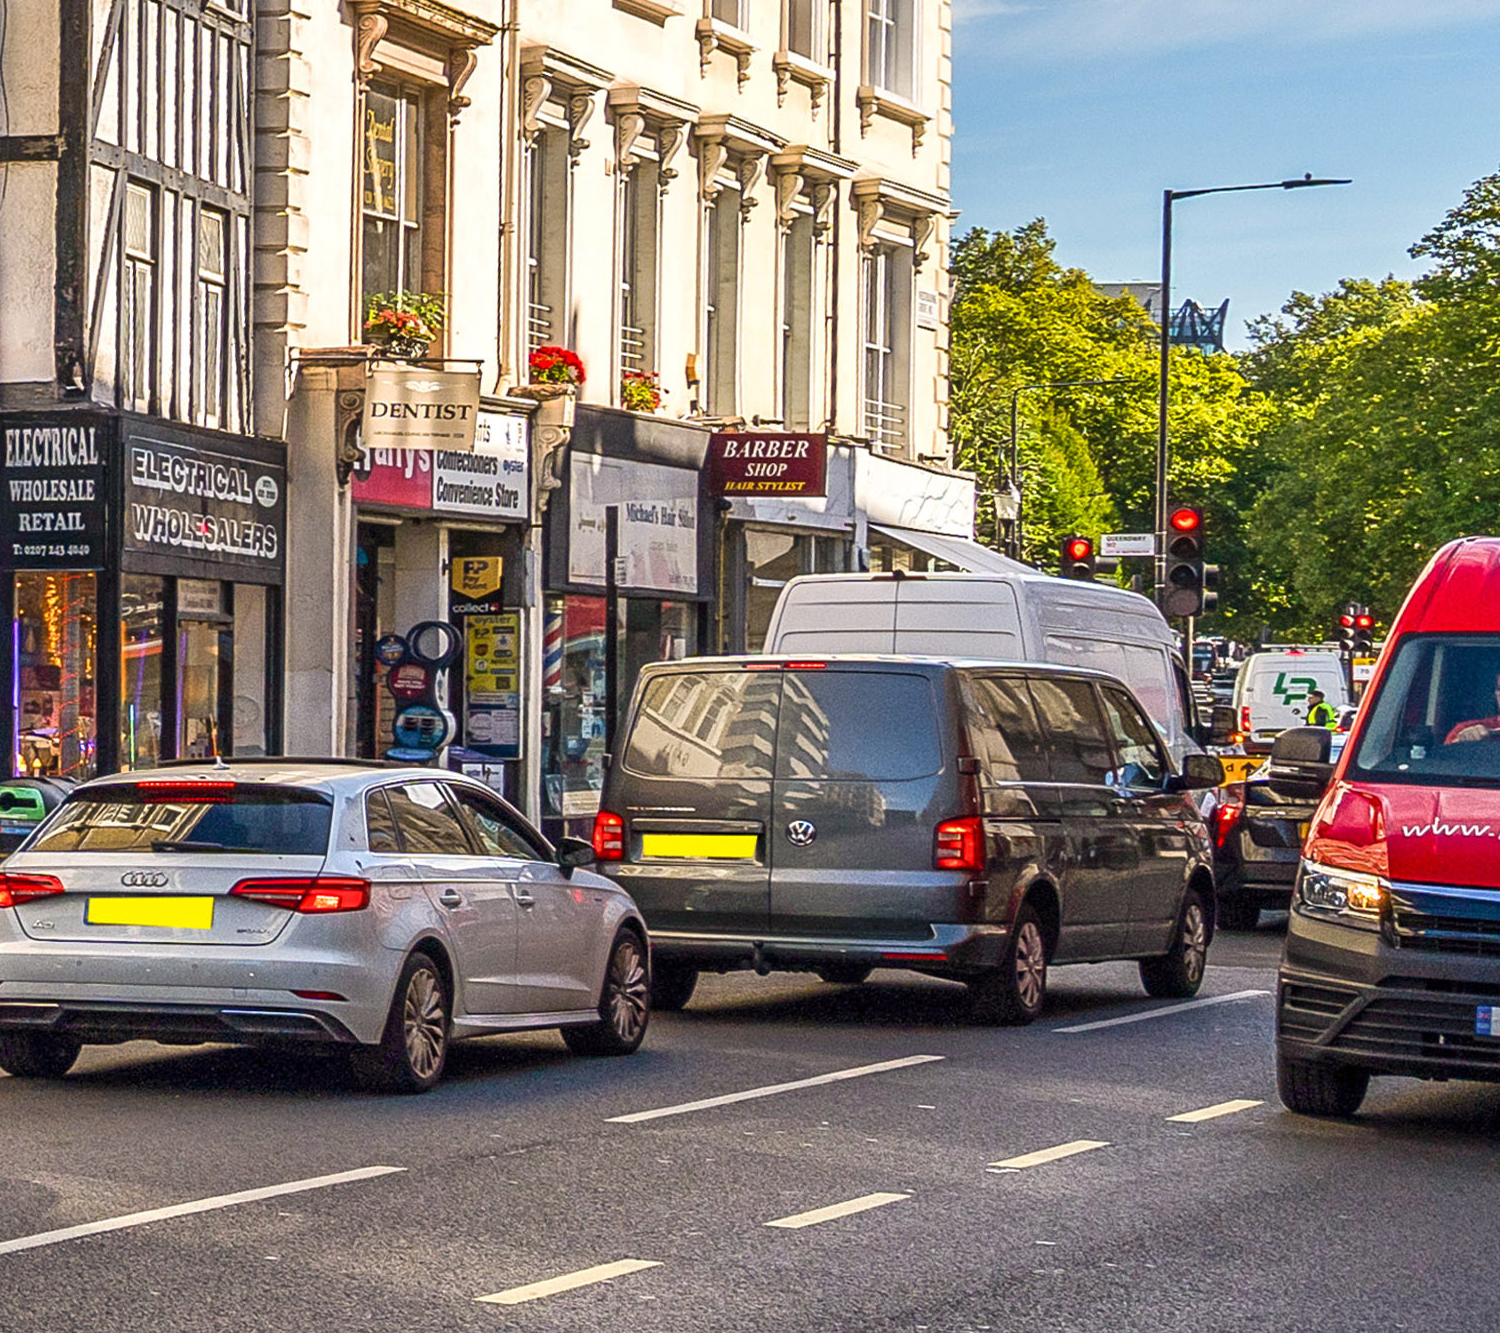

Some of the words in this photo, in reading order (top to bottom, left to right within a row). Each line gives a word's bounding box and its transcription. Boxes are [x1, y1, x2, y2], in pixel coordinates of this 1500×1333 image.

[371, 402, 473, 420] DENTIST
[5, 426, 99, 467] ELECTRICAL
[723, 440, 810, 458] BARBER
[131, 447, 253, 504] ELECTRICAL
[744, 463, 788, 477] SHOP
[9, 479, 95, 502] WHOLESALE
[436, 476, 493, 506] Convenience
[495, 482, 519, 509] Store
[724, 481, 755, 490] HAIR
[756, 481, 806, 490] STYLIST
[18, 512, 86, 531] RETAIL
[131, 502, 278, 559] WHOLESALERS
[24, 545, 46, 556] 0207
[48, 545, 65, 556] 243
